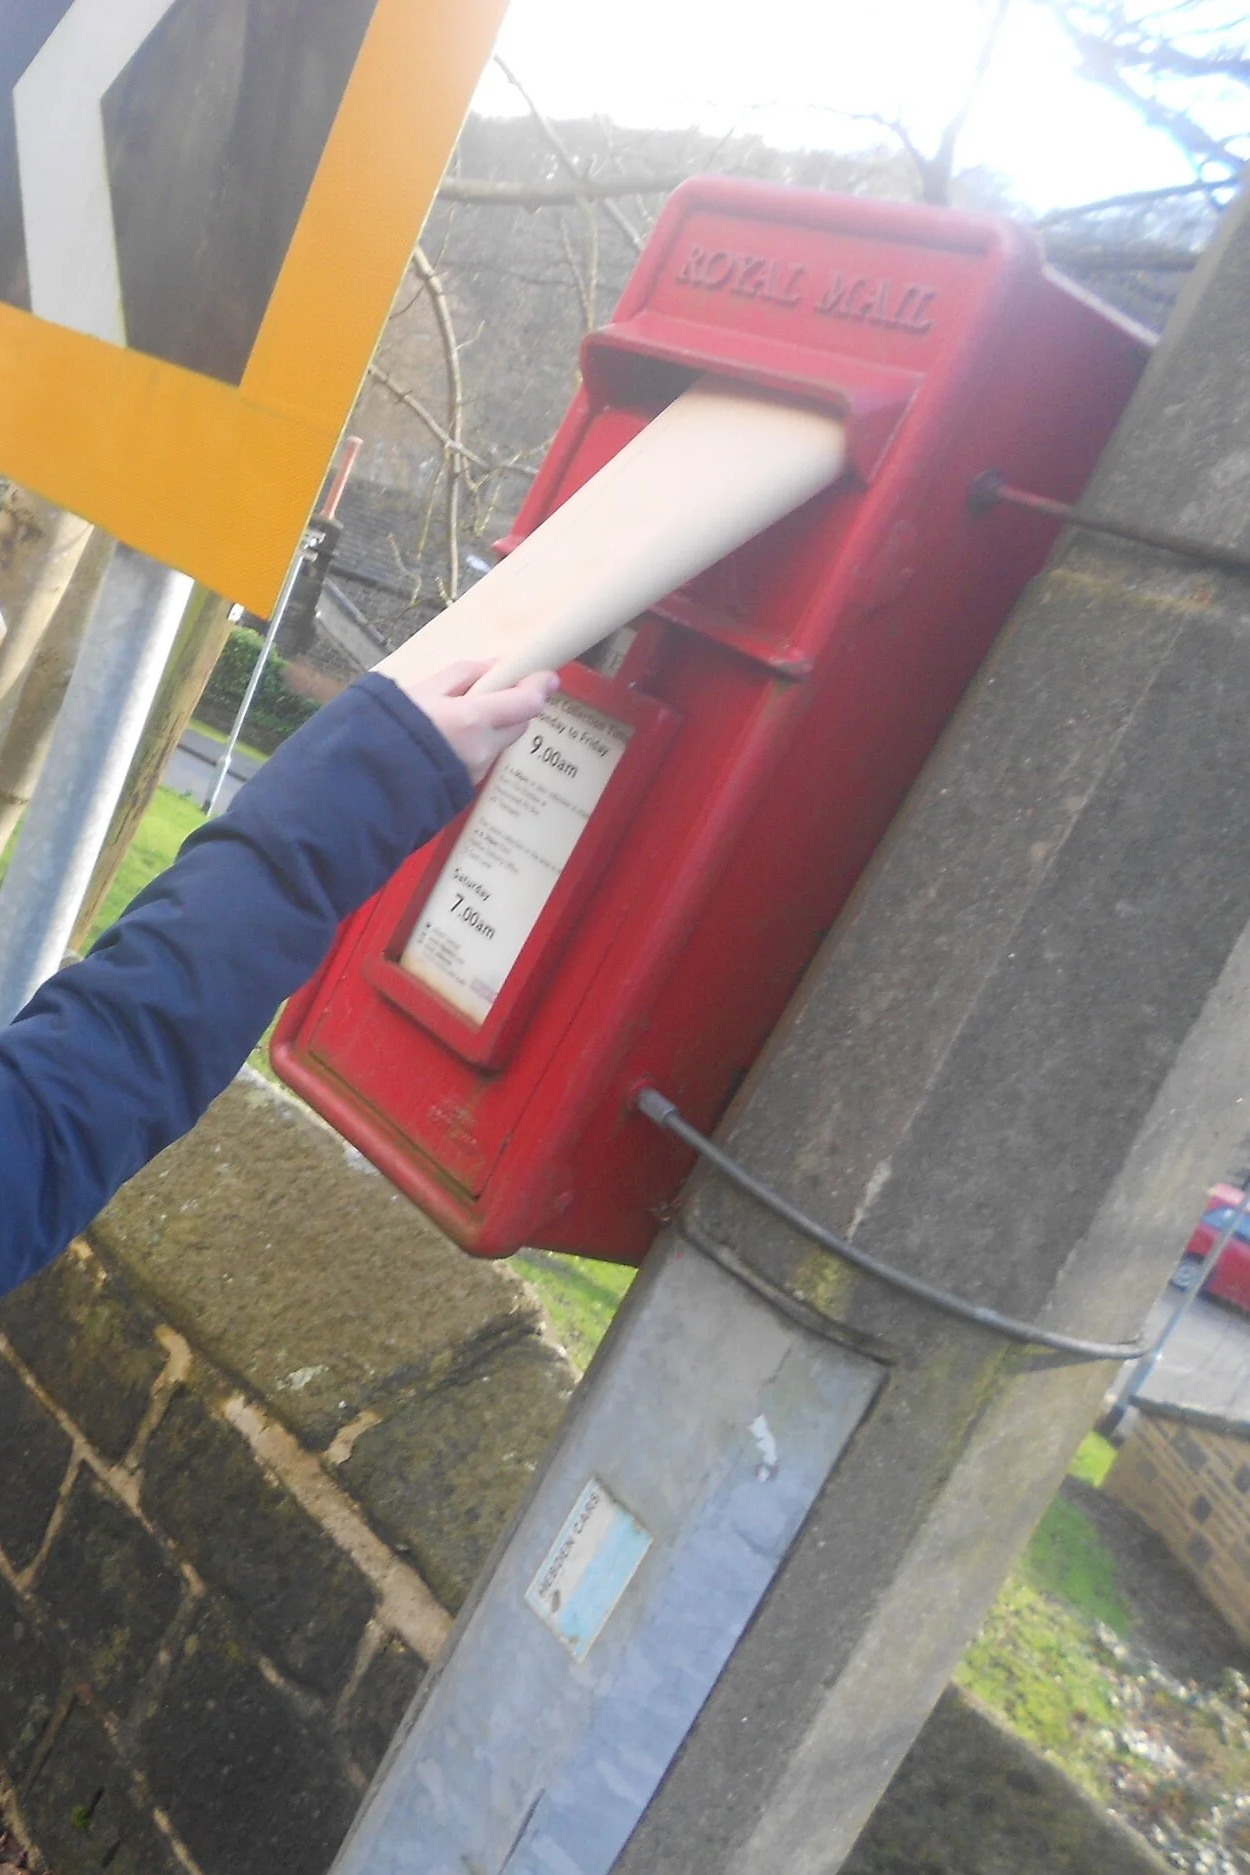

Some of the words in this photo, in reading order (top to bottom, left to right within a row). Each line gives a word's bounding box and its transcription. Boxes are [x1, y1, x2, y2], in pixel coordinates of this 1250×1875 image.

[676, 245, 806, 308] ROYAL
[814, 270, 937, 336] MAIL
[529, 735, 579, 779] 9.00am
[536, 711, 567, 735] onday
[568, 726, 579, 740] to
[580, 730, 610, 759] Friday
[453, 867, 491, 902] Saturday
[450, 893, 496, 941] 7.00am
[573, 1491, 600, 1535] CARS
